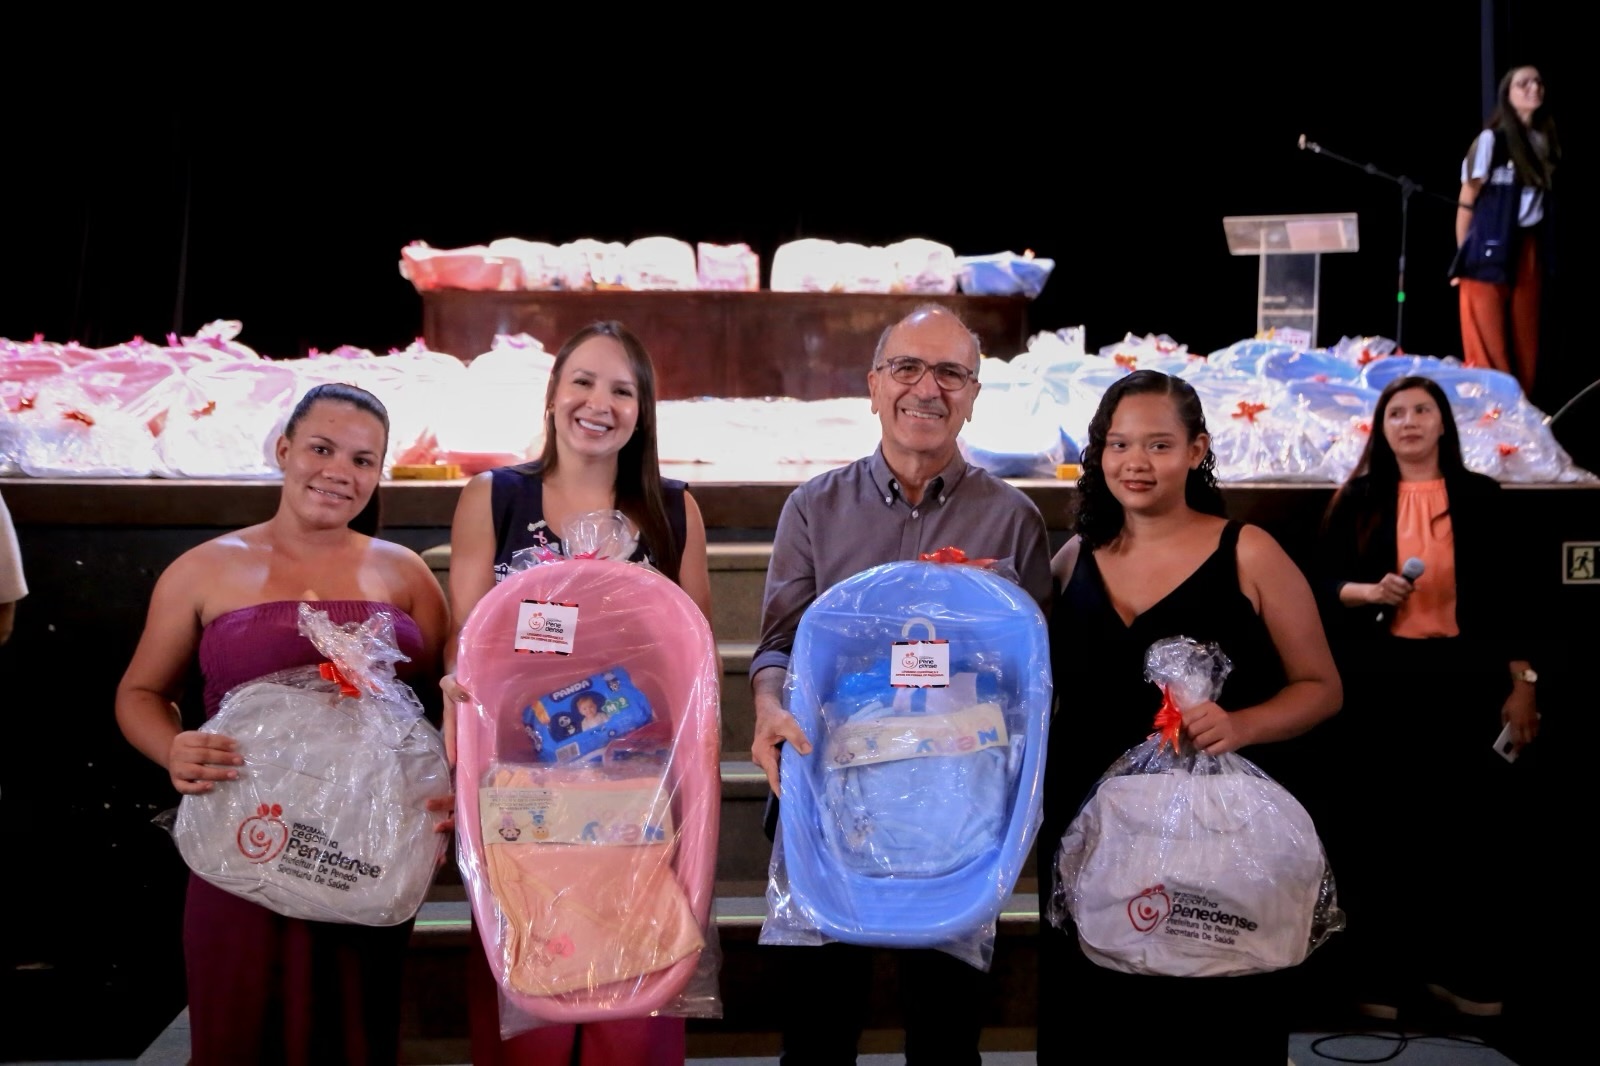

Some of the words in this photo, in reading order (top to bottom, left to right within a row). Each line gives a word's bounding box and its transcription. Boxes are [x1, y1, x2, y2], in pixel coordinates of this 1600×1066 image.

[552, 680, 590, 701] PANDA
[285, 837, 381, 878] Penedense
[317, 864, 329, 875] De
[330, 868, 358, 883] Penedo
[314, 875, 326, 885] De
[328, 878, 350, 892] Saúde
[1170, 903, 1258, 932] Penedense
[1202, 922, 1212, 931] De
[1214, 925, 1240, 936] Penedo
[1202, 932, 1212, 941] De
